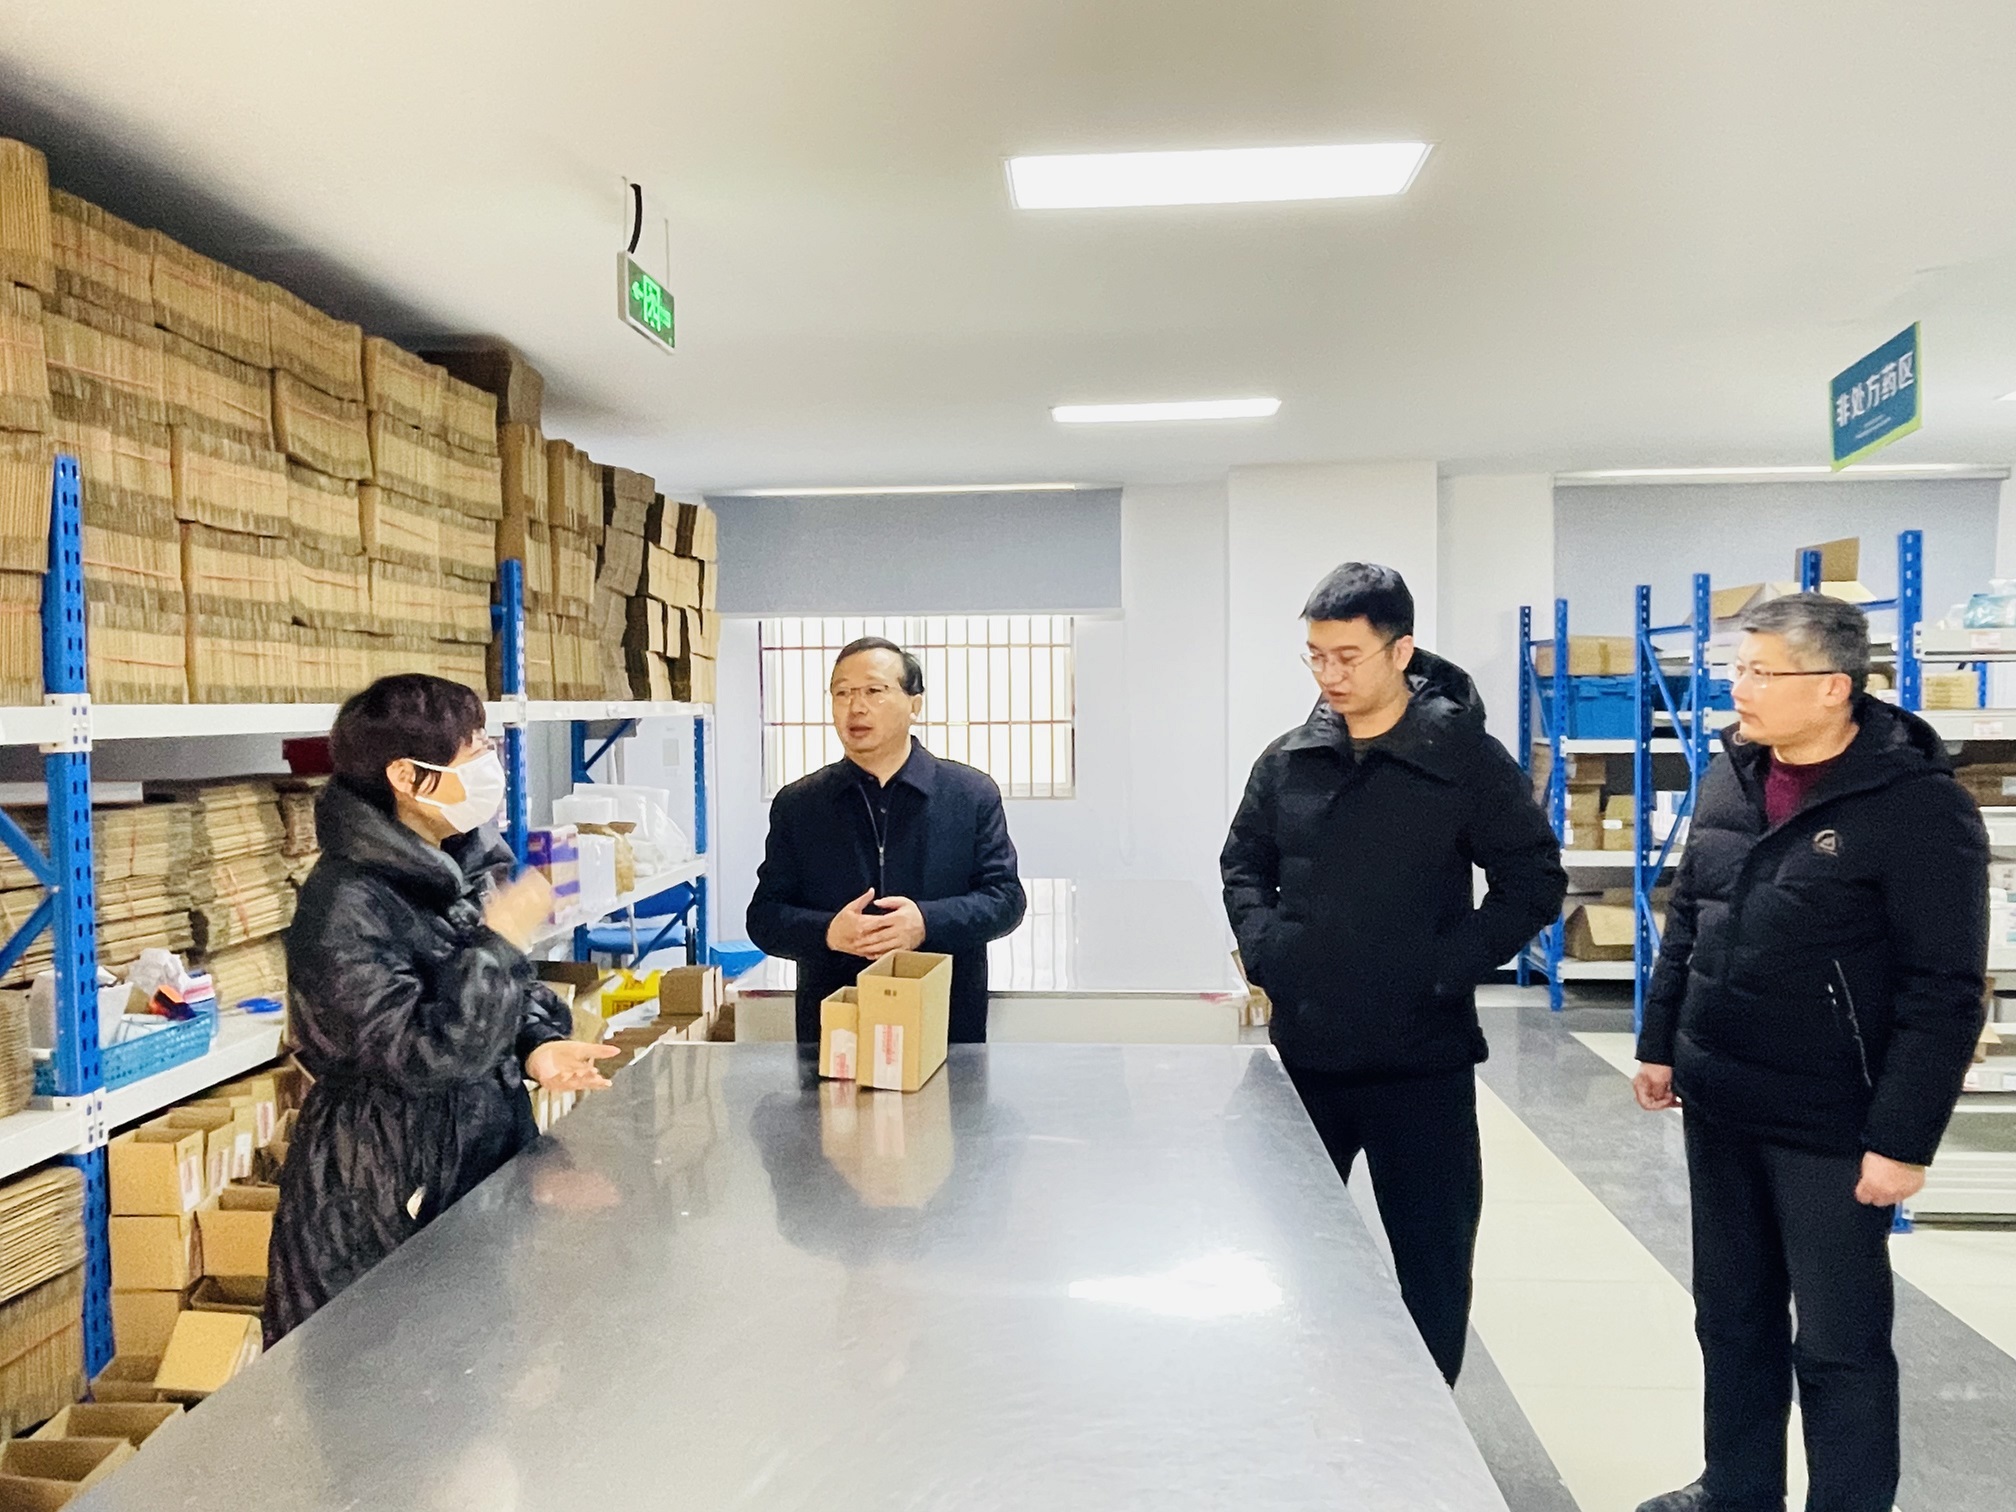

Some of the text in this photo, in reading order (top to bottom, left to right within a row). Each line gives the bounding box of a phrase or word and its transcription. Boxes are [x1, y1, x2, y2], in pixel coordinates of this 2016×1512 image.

[1836, 351, 1915, 427] 非处方药区
